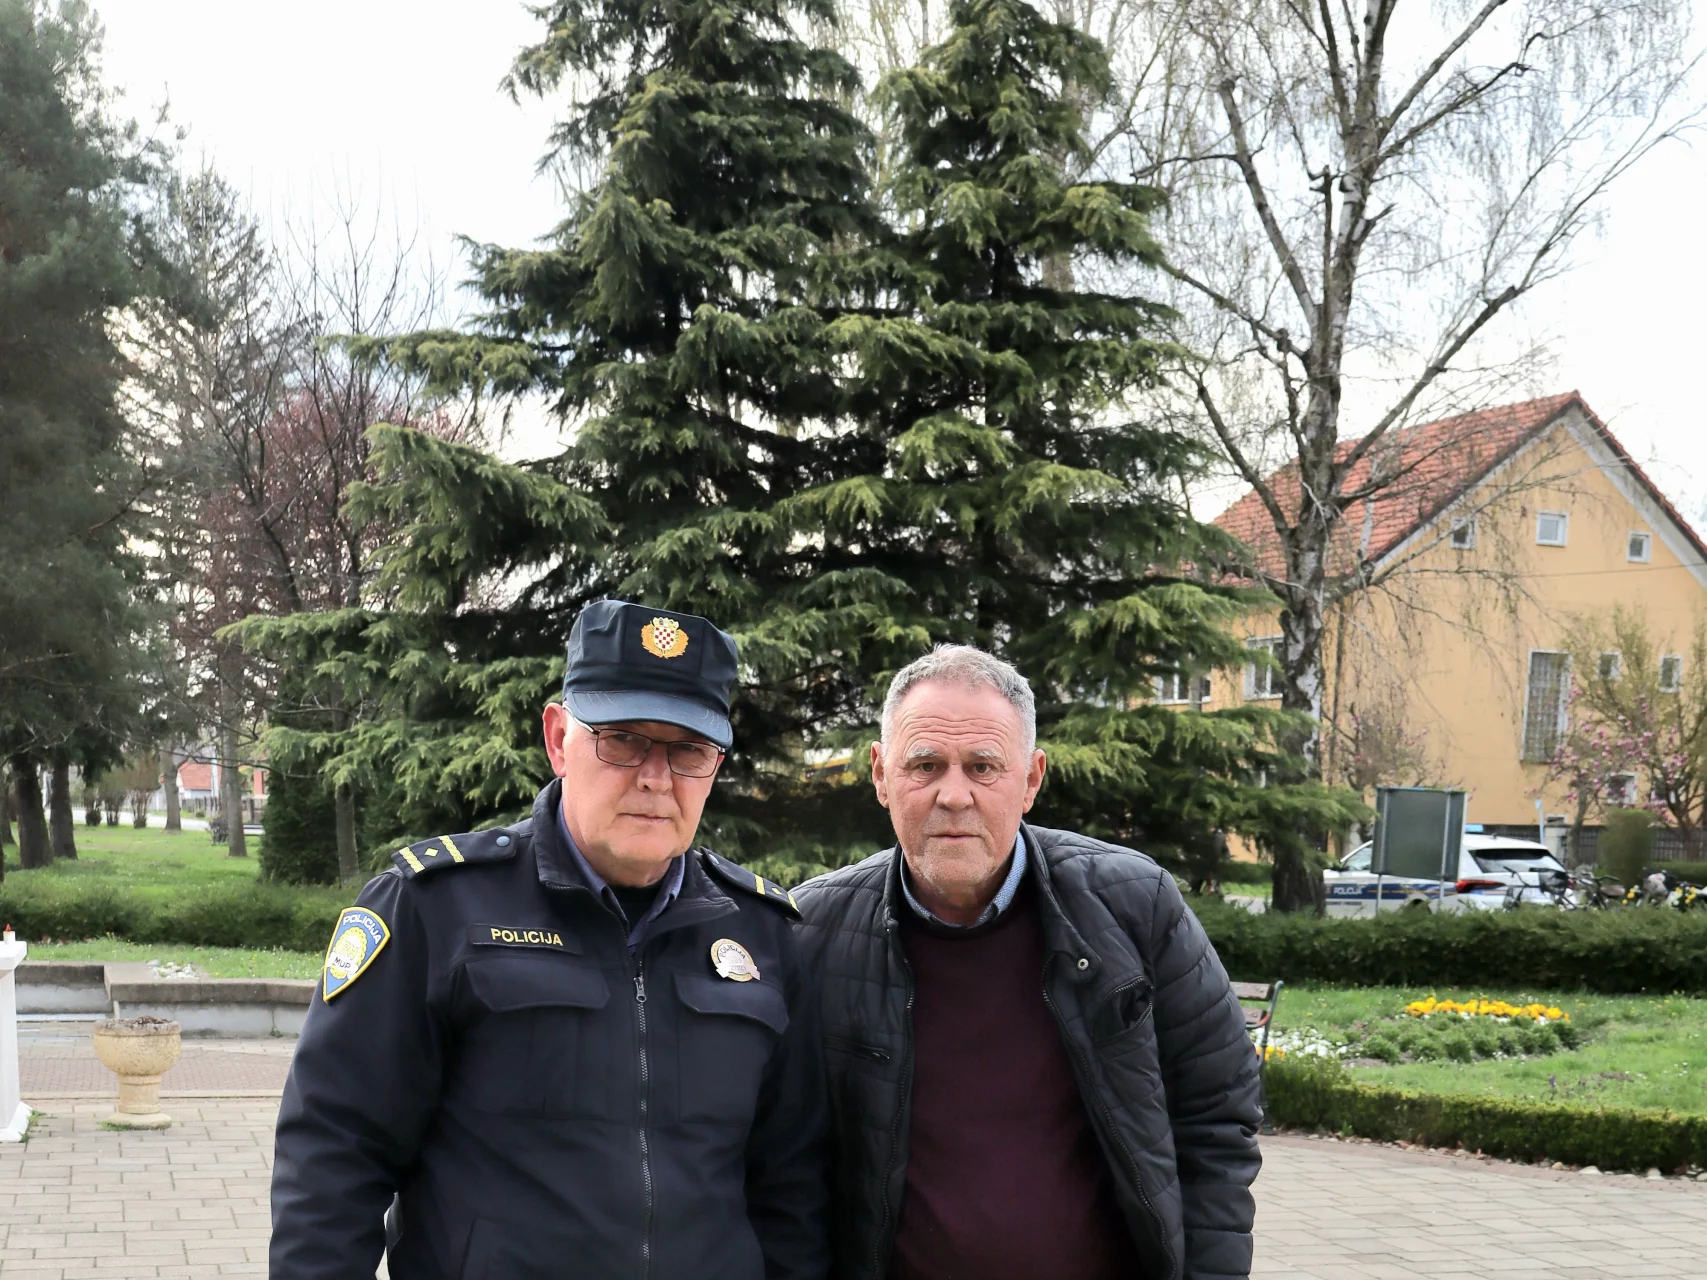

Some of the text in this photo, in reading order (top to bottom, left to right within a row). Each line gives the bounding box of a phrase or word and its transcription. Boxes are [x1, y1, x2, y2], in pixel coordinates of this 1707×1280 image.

[342, 913, 382, 945] POLICIJA
[490, 927, 564, 947] POLICIJA
[719, 944, 746, 959] POLICIJA
[334, 956, 352, 969] MUP
